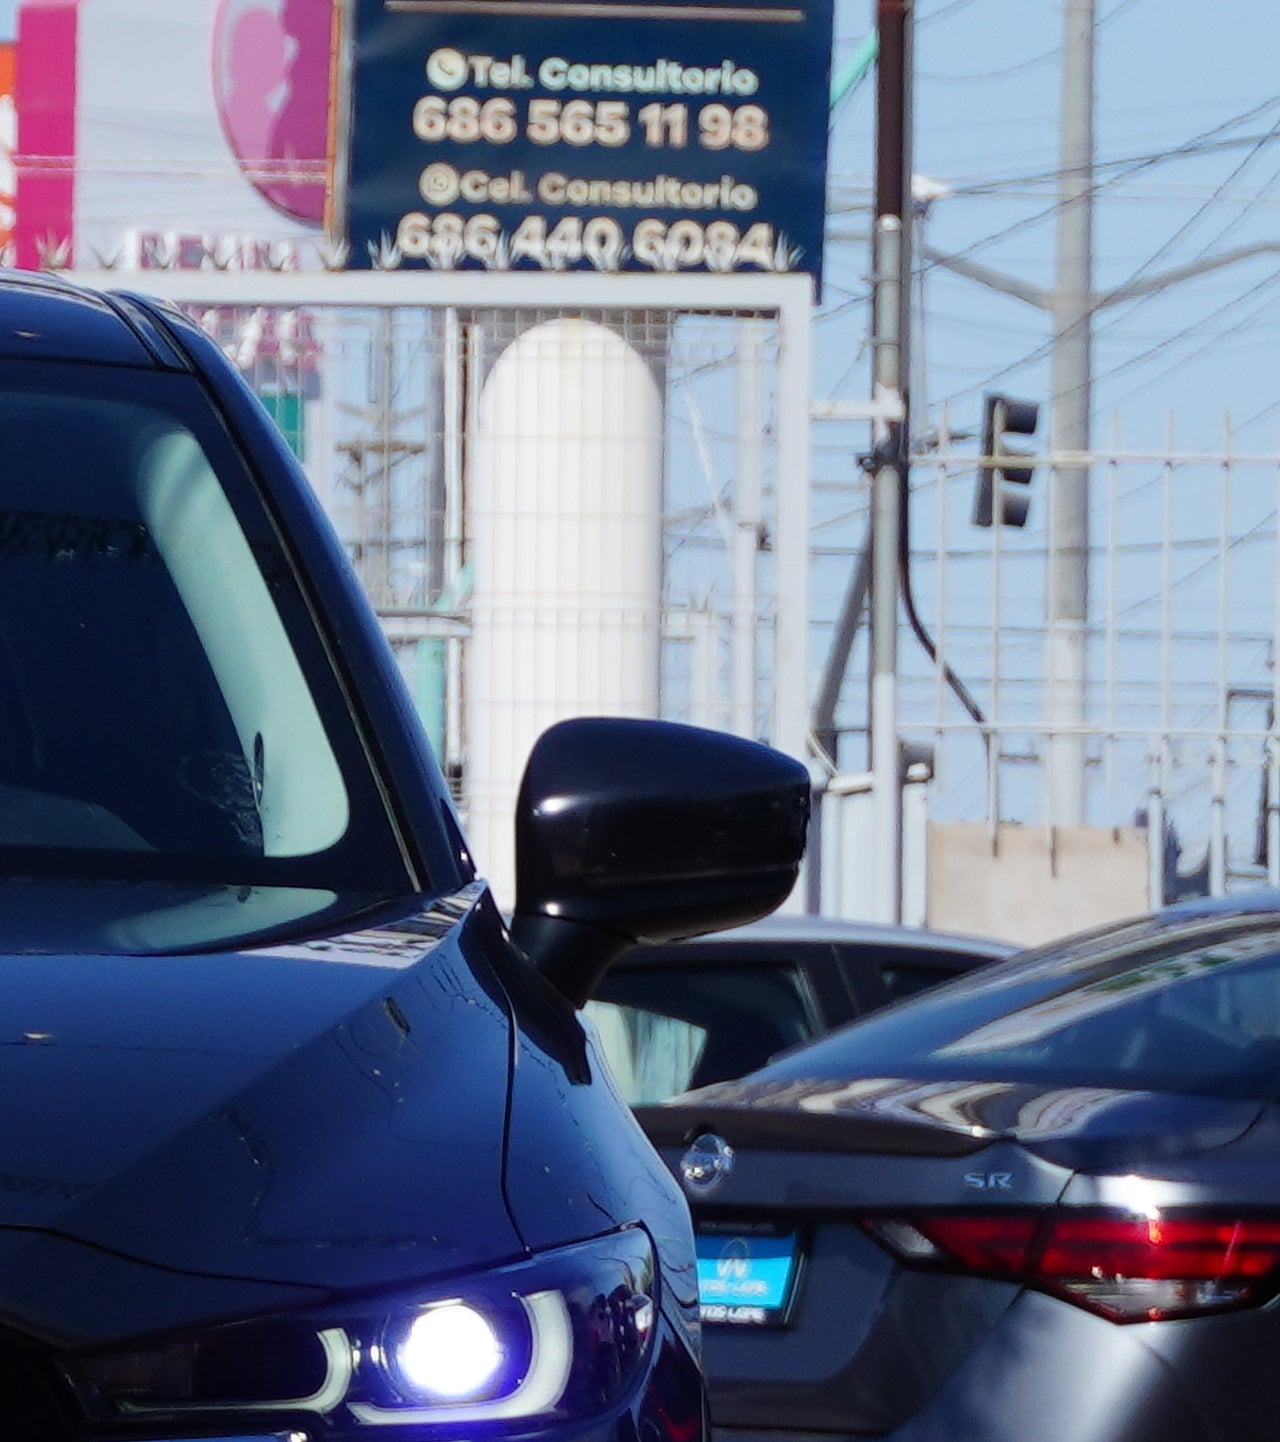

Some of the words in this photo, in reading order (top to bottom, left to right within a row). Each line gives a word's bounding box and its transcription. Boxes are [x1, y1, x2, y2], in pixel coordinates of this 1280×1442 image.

[468, 54, 535, 90] Tel.
[539, 56, 759, 96] Consultorio
[413, 95, 517, 145] 686
[526, 99, 630, 147] 565
[638, 102, 689, 149] 11
[698, 103, 769, 151] 98
[459, 169, 533, 204] Cel.
[538, 171, 758, 212] Consultorio
[397, 211, 499, 261] 686
[509, 215, 623, 264] 440
